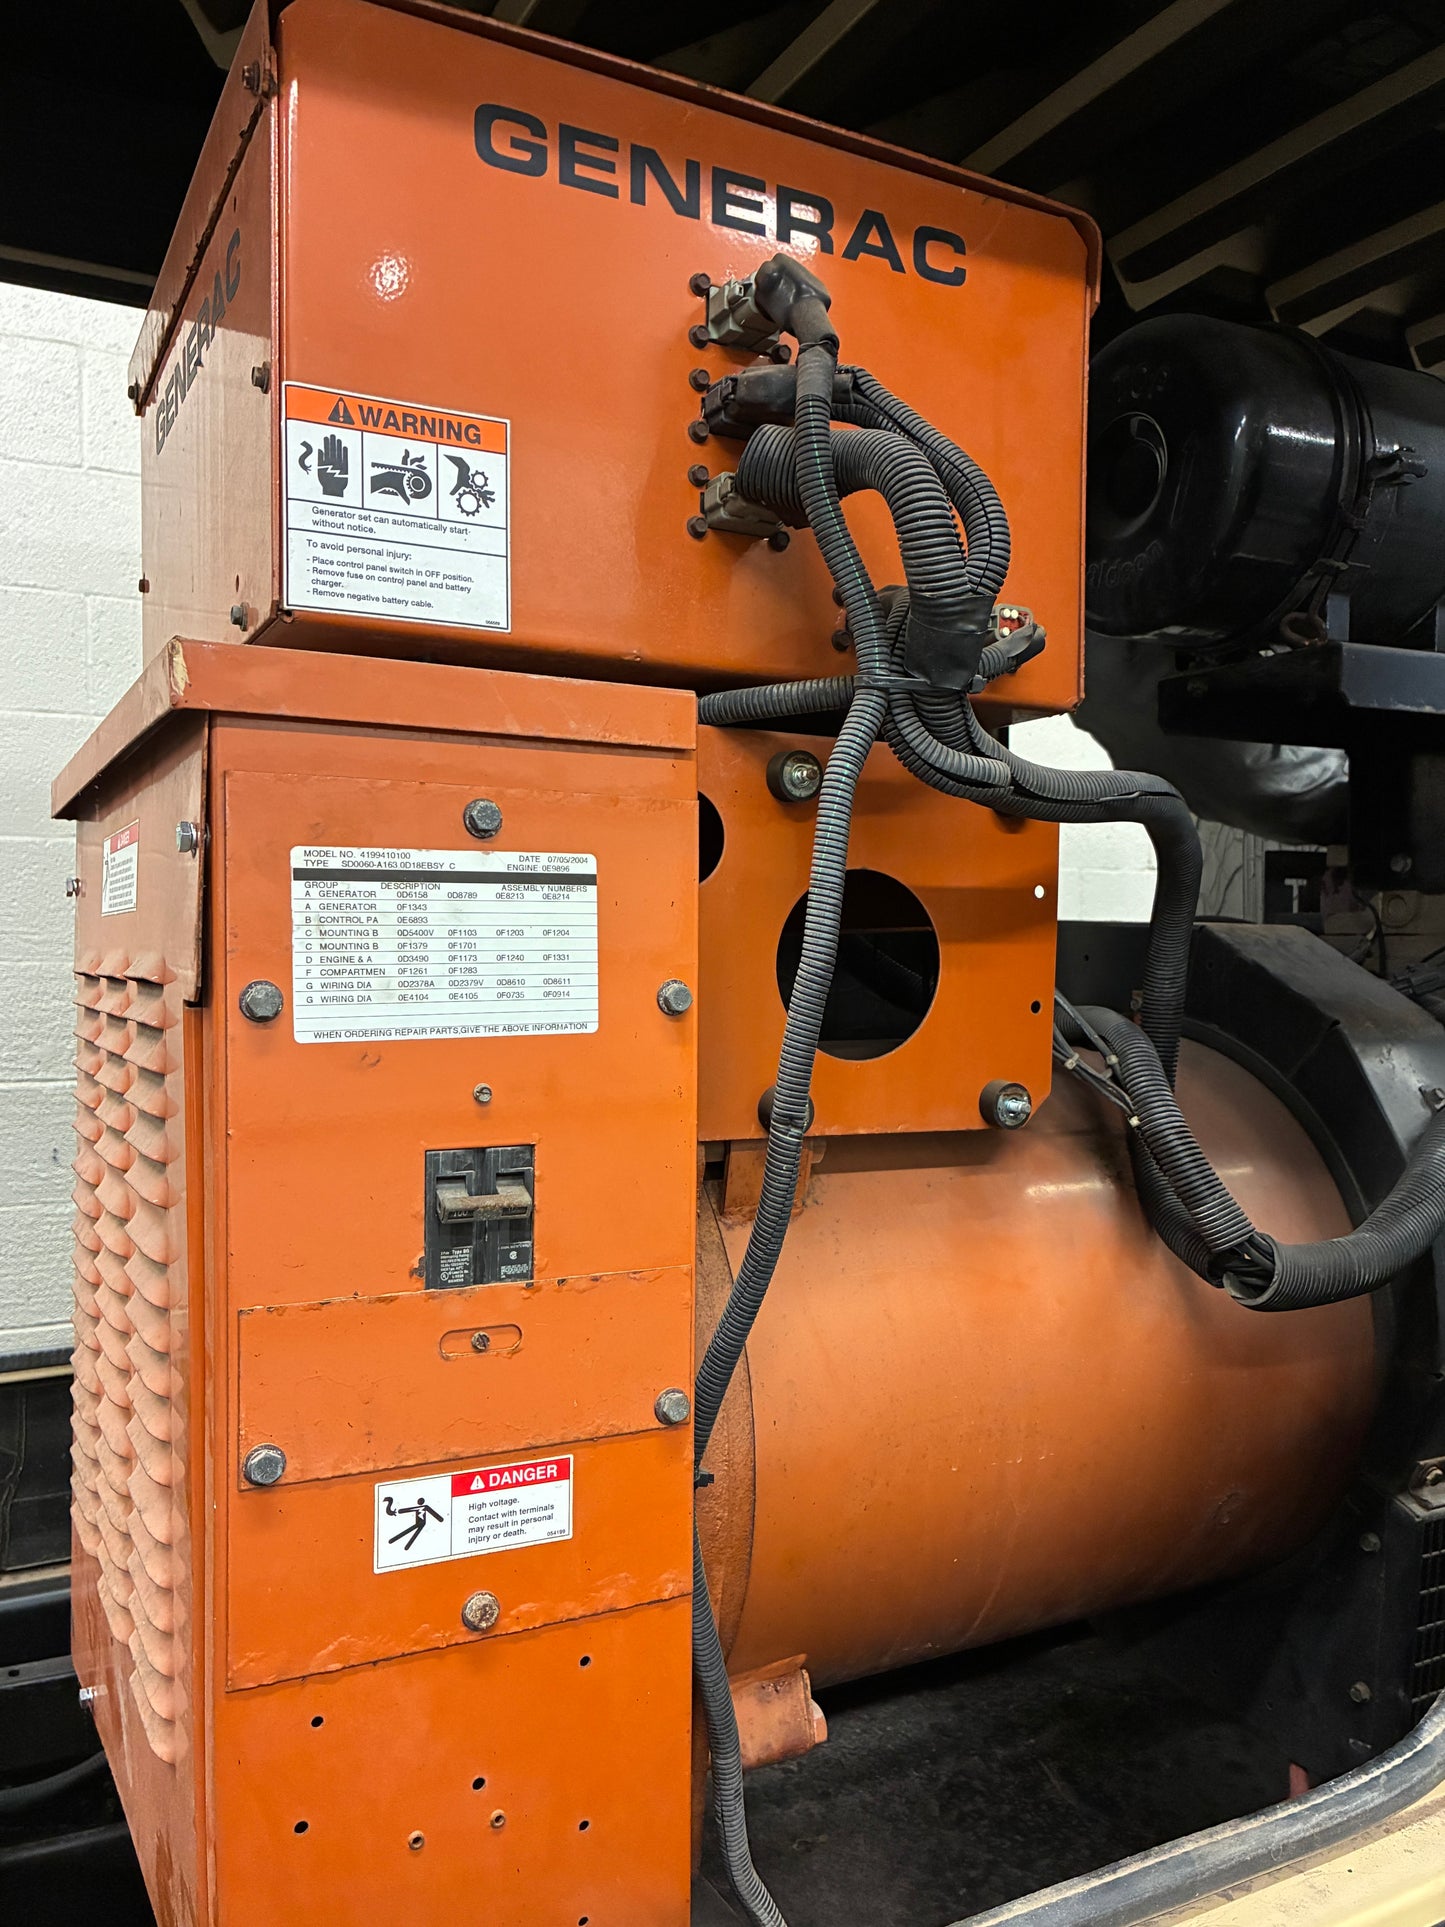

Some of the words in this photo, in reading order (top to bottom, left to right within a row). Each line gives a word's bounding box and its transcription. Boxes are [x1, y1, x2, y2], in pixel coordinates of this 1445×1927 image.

[474, 103, 967, 287] GENERAC
[156, 228, 241, 455] GENERAC
[358, 405, 481, 444] WARNING
[312, 506, 356, 519] Generator
[358, 513, 371, 521] set
[374, 515, 389, 524] can
[391, 518, 447, 533] automatically
[312, 518, 345, 529] without
[347, 523, 376, 534] notice.
[306, 539, 318, 548] To
[320, 541, 344, 551] avoid
[347, 544, 384, 556] personal
[386, 550, 412, 560] injury:
[312, 556, 334, 565] Place
[337, 559, 364, 569] control
[366, 563, 387, 572] panel
[389, 566, 413, 575] switch
[425, 570, 440, 578] OFF
[443, 573, 474, 583] position.
[312, 567, 345, 577] Remove
[347, 571, 363, 580] fuse
[377, 575, 404, 586] control
[407, 579, 427, 588] panel
[445, 583, 471, 594] battery
[312, 578, 344, 589] charger.
[312, 588, 345, 598] Remove
[347, 593, 380, 603] negative
[382, 596, 409, 606] battery
[411, 600, 434, 608] cable.
[304, 850, 336, 858] MODEL
[547, 856, 588, 864] 07/05/2004
[320, 968, 385, 976] COMPARTMEN
[398, 980, 435, 988] 0D2378A
[314, 1031, 341, 1039] WHEN
[344, 1030, 392, 1038] ORDERING
[395, 1028, 427, 1036] REPAIR
[532, 1023, 588, 1031] INFORMATION
[489, 1464, 558, 1487] DANGER
[469, 1502, 486, 1511] High
[489, 1498, 519, 1507] voltage.
[469, 1513, 499, 1523] Contact
[501, 1510, 517, 1518] with
[519, 1504, 554, 1515] terminals
[468, 1525, 485, 1533] may
[487, 1521, 509, 1531] result
[520, 1513, 553, 1526] personal
[468, 1534, 490, 1544] injury
[503, 1529, 526, 1537] death.
